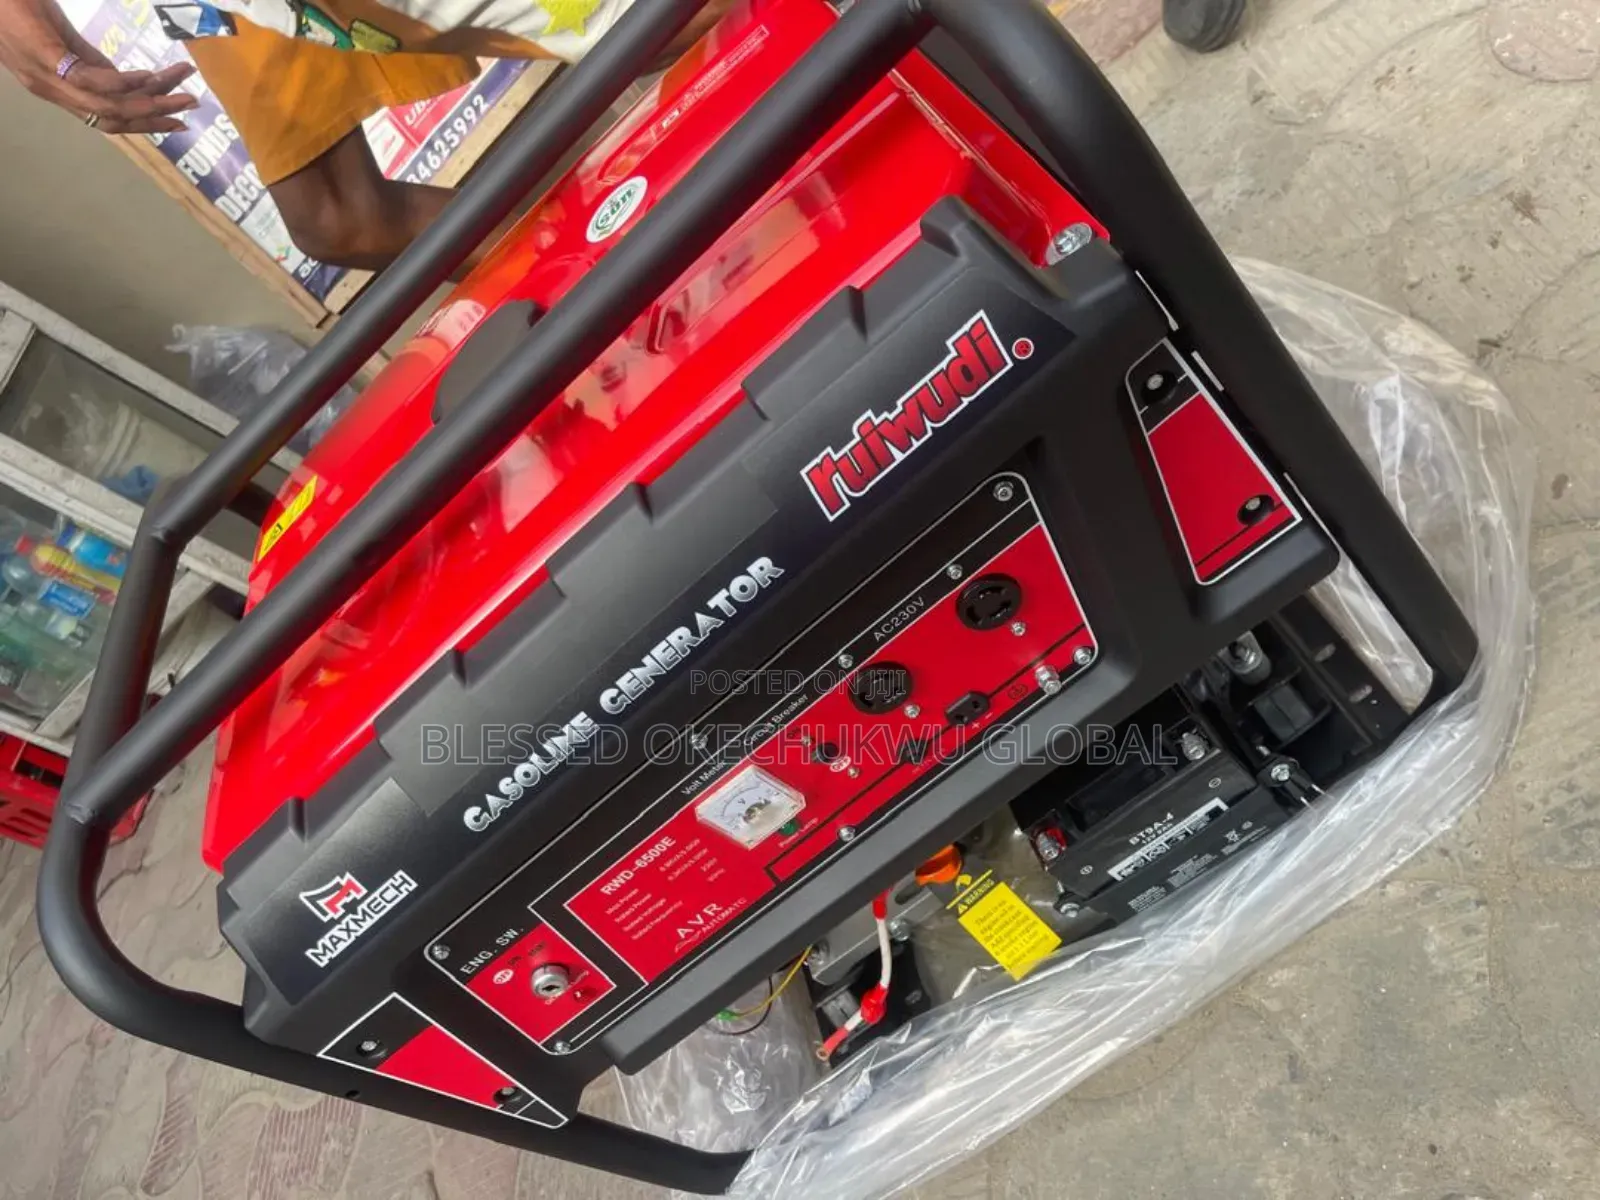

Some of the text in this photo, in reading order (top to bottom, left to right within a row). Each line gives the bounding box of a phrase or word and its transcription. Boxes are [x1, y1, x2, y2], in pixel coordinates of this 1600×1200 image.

[801, 310, 1013, 521] ruiwudi
[873, 597, 925, 642] AC230V
[463, 711, 600, 832] GASOLINE
[599, 556, 785, 715] GENERATOR
[600, 835, 677, 896] RWD-6500E
[305, 869, 419, 967] MAXMECH
[460, 927, 524, 974] ENG. SW.
